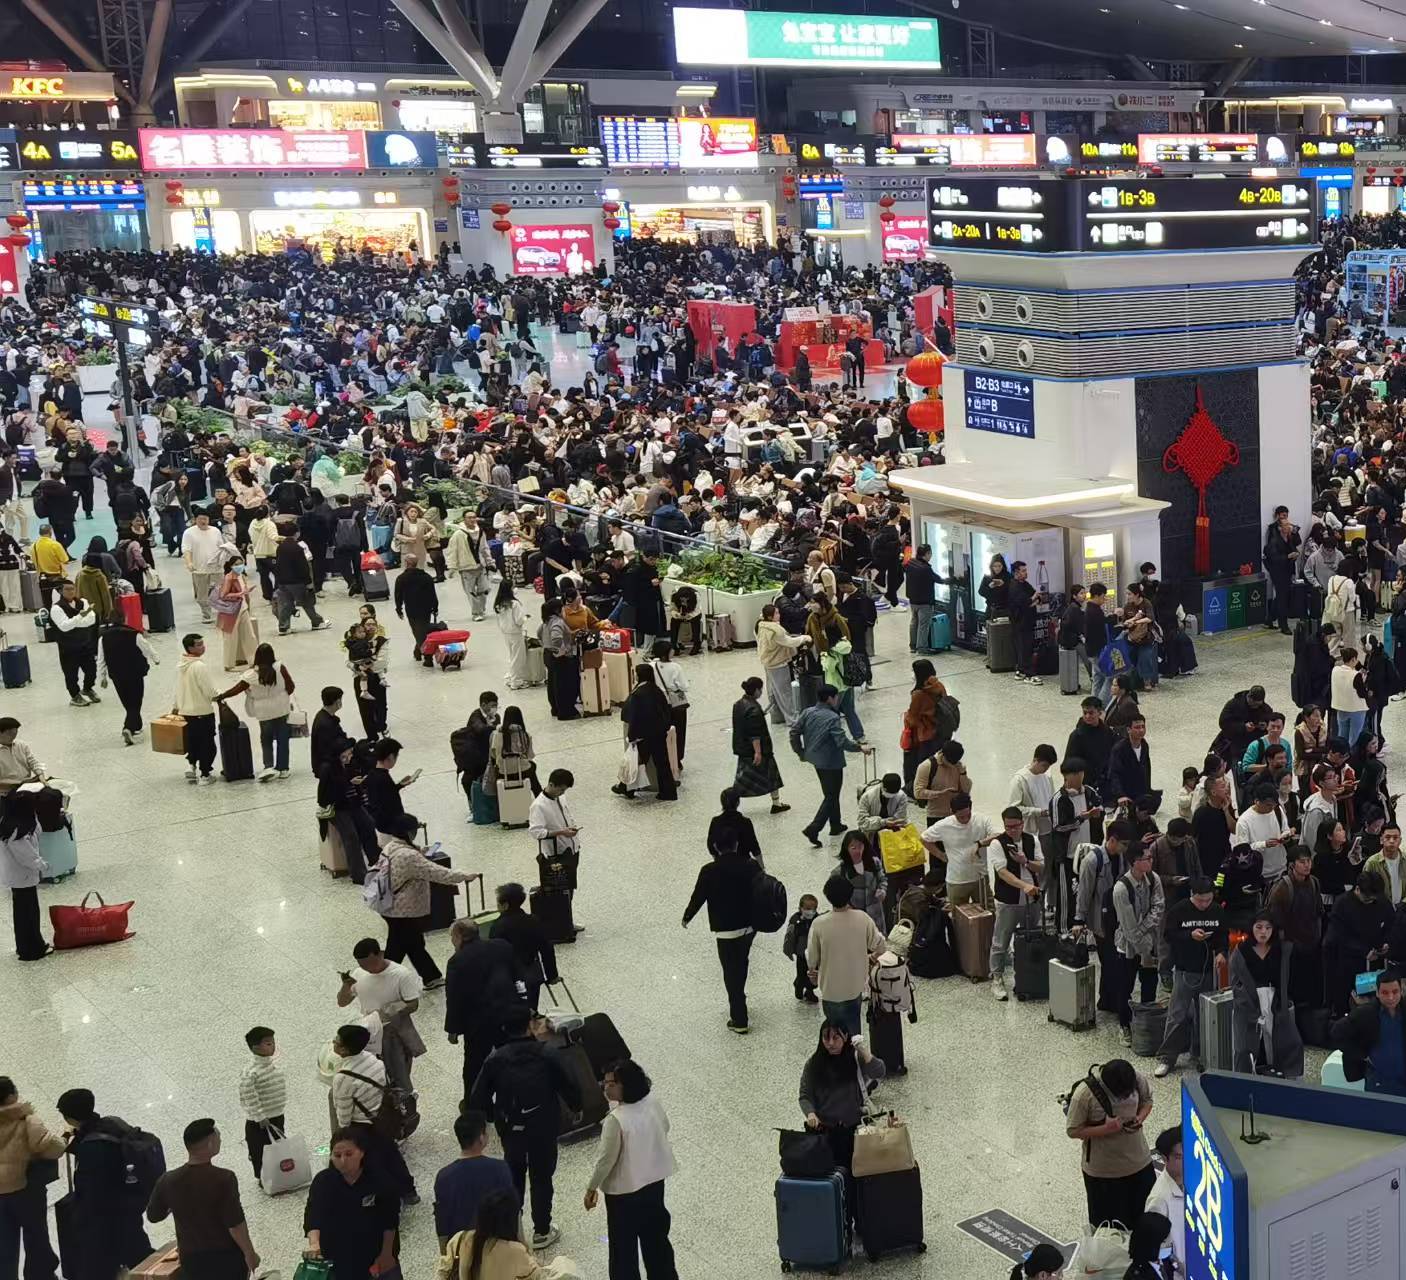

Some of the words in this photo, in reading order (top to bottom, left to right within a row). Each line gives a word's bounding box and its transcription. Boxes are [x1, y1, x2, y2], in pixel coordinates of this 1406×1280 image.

[11, 78, 64, 94] KFC
[22, 141, 51, 159] 4A
[111, 141, 138, 160] 5A
[801, 143, 820, 160] 8A
[1081, 143, 1098, 156] 10A
[1122, 143, 1138, 156] 11A
[1302, 142, 1318, 155] 12A
[1338, 142, 1354, 155] 13A
[1118, 189, 1156, 206] 1B-3B
[1239, 187, 1281, 203] 4B-20B
[952, 223, 981, 238] 2A-20A
[996, 225, 1021, 240] 1B-3B
[991, 398, 998, 412] B
[1193, 1139, 1223, 1253] 2B
